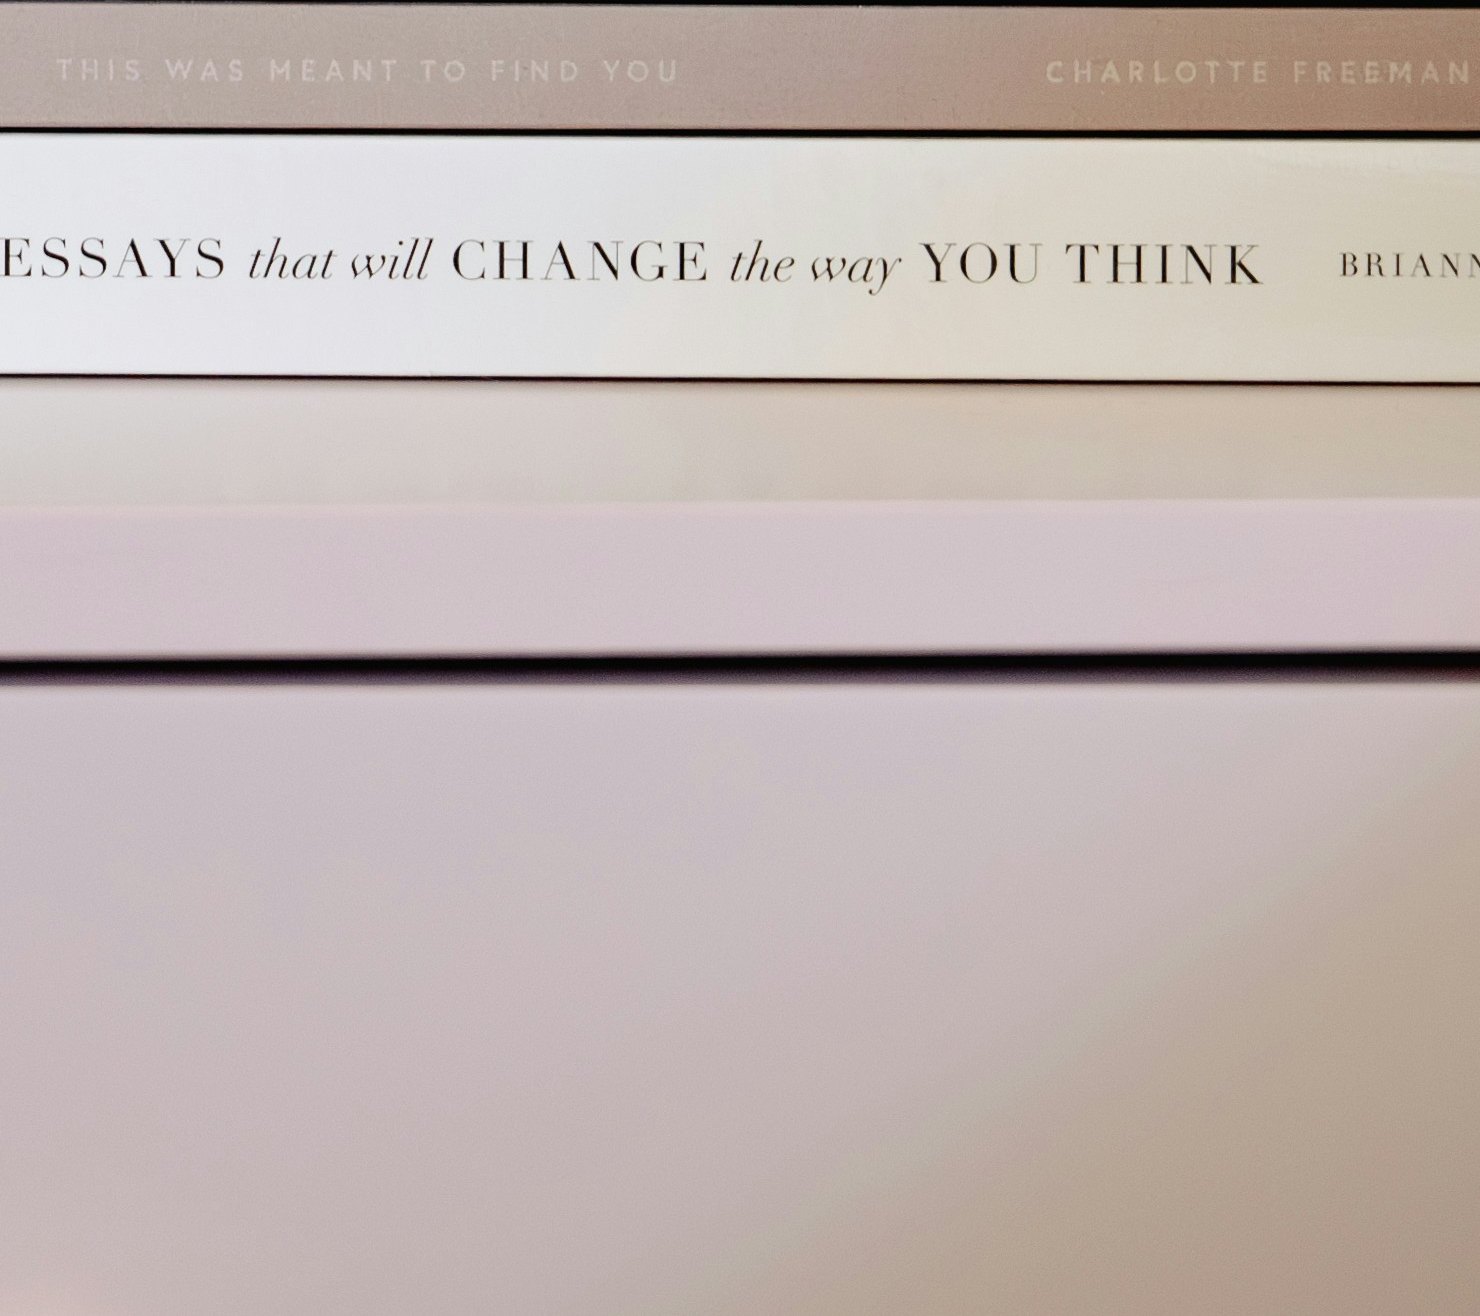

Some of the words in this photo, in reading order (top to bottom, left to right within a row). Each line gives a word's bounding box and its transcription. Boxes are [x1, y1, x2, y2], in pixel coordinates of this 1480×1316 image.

[56, 57, 141, 82] THIS
[164, 58, 244, 82] WAS
[269, 58, 397, 83] MEANT
[420, 58, 467, 83] TO
[491, 58, 578, 83] FIND
[602, 59, 677, 83] YOU
[1045, 59, 1268, 85] CHARLOTTE
[1292, 60, 1471, 85] FREEMAN
[247, 235, 336, 281] that
[349, 236, 434, 281] will
[451, 239, 709, 283] CHANGE
[729, 239, 797, 283] the
[809, 256, 904, 297] way
[919, 241, 1043, 285] YOU
[1064, 242, 1264, 285] THINK
